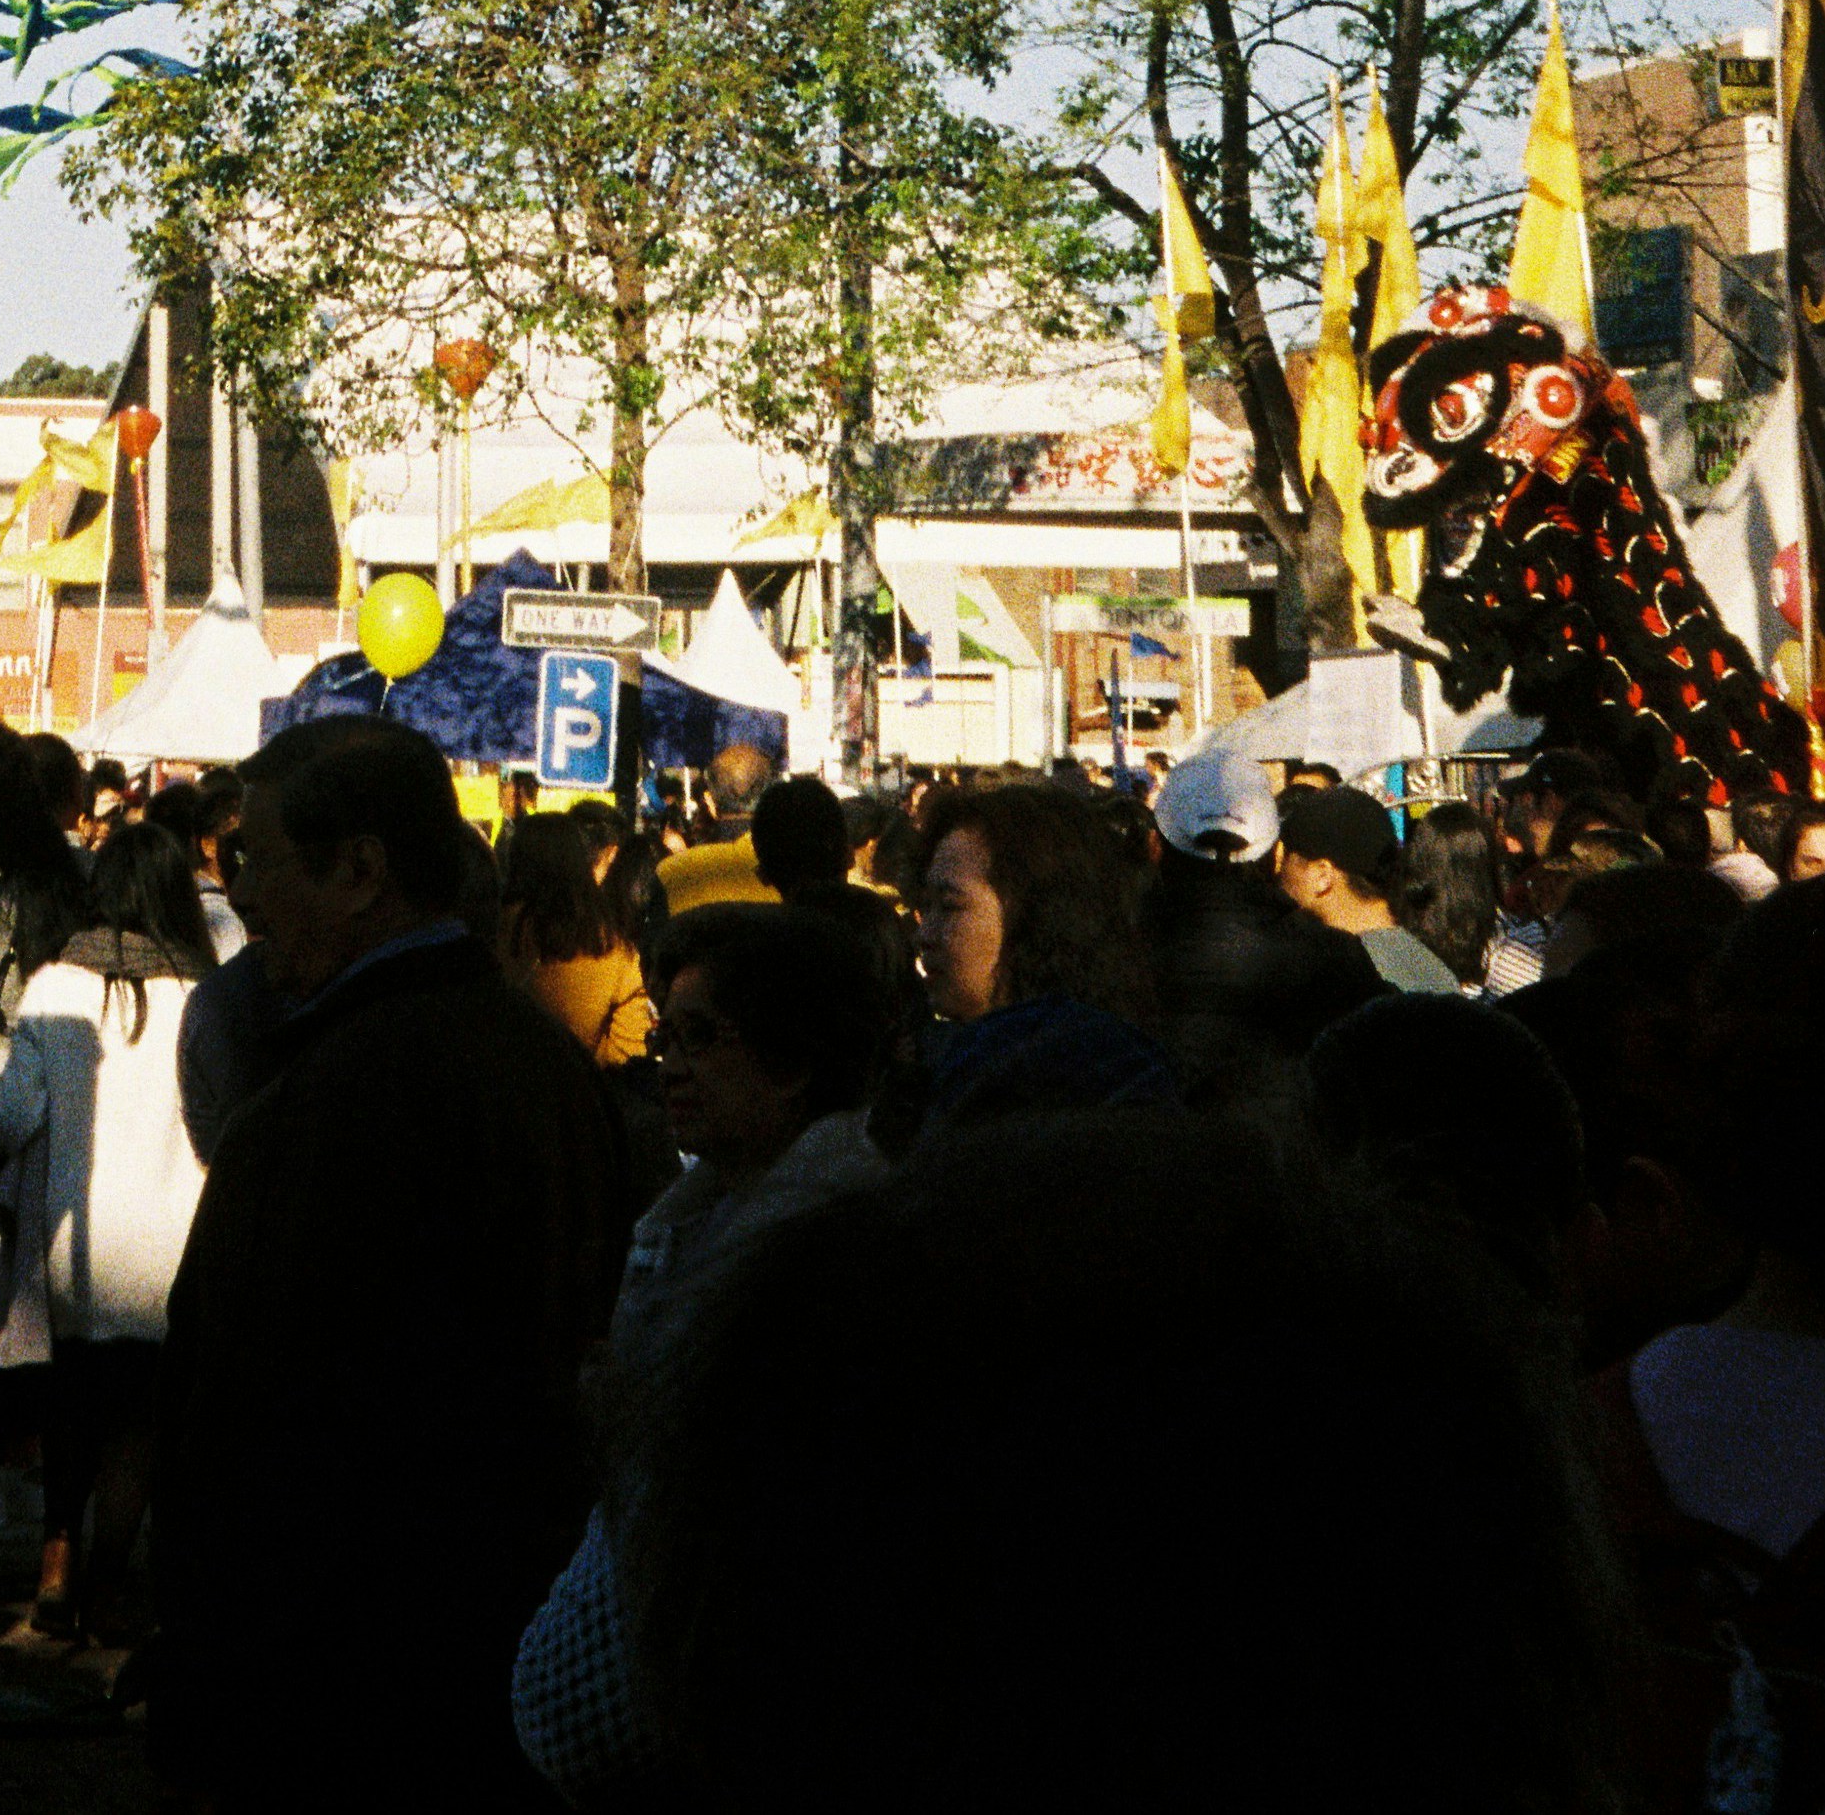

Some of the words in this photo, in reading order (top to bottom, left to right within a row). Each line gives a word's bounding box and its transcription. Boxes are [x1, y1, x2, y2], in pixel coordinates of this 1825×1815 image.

[521, 608, 559, 629] ONE
[572, 610, 613, 631] WAY
[551, 706, 602, 770] P
